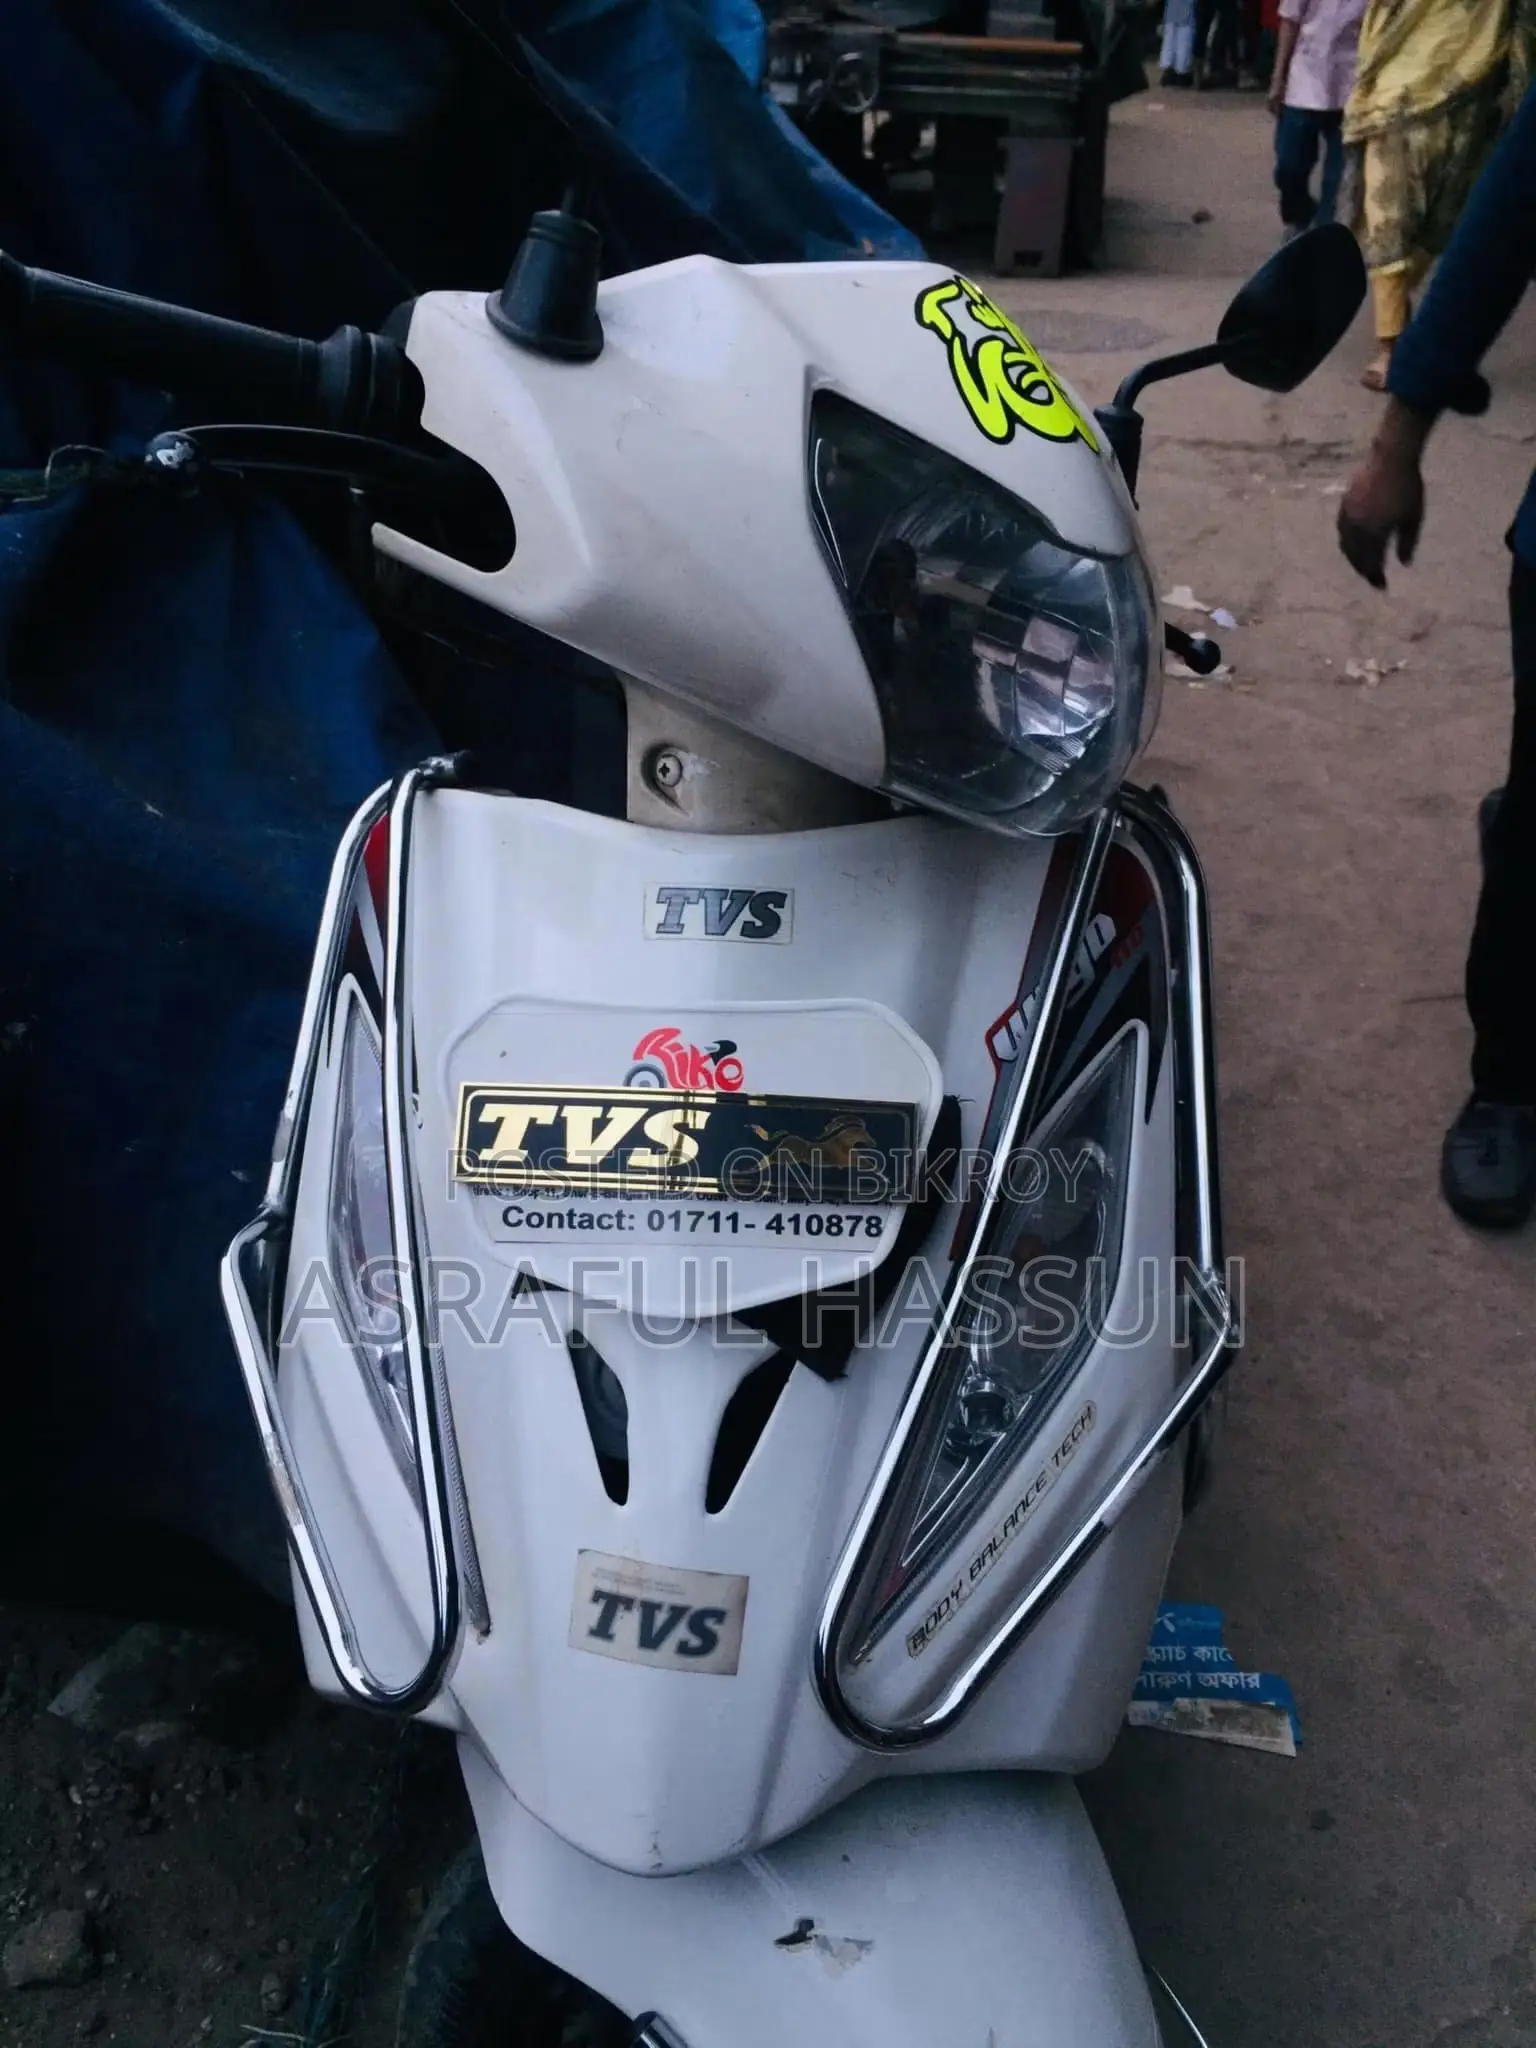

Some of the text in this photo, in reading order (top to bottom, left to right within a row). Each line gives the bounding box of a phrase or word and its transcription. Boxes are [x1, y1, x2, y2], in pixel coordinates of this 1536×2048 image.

[655, 887, 789, 940] TVS
[477, 1102, 711, 1169] TVS
[502, 1205, 883, 1239] Contact: 01711- 410878
[911, 1405, 1094, 1651] BODY BALANCE TECH
[587, 1588, 728, 1659] TVS
[1196, 1672, 1261, 1689] অফার
